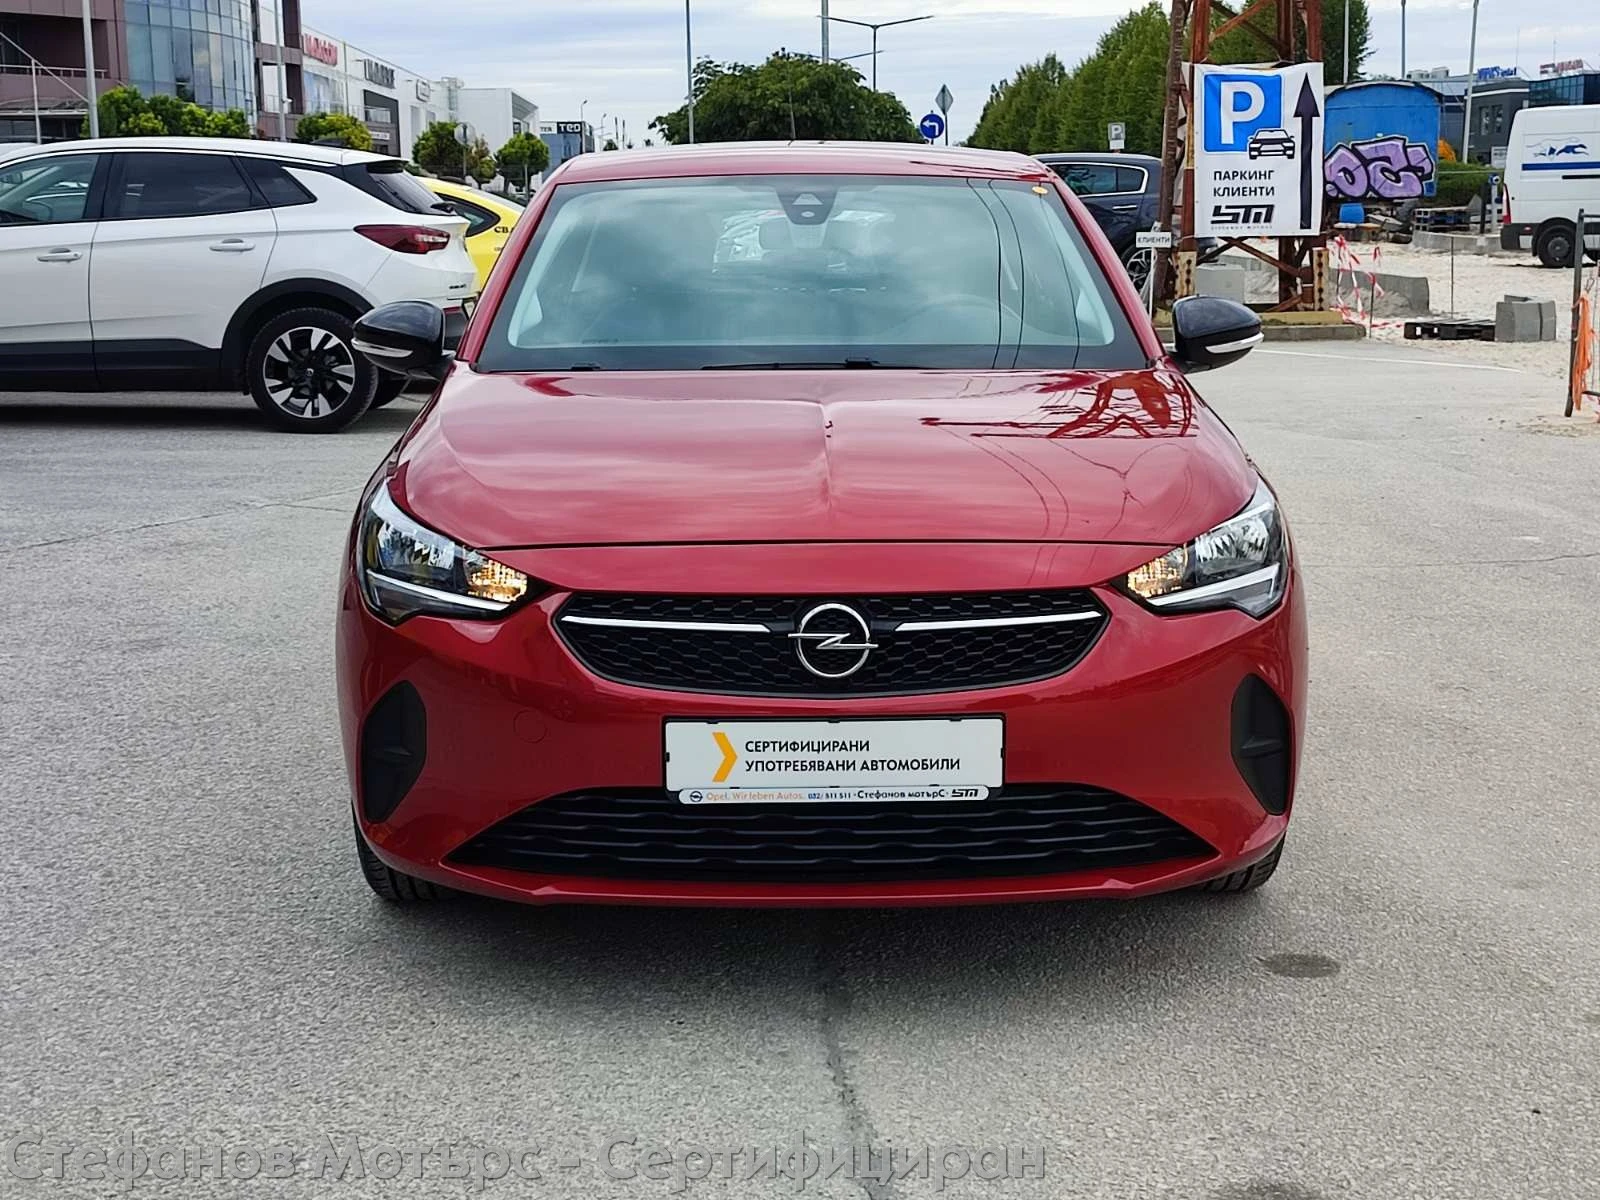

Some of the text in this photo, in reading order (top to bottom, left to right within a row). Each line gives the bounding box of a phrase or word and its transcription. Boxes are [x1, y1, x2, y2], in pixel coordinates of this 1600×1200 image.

[1220, 81, 1265, 145] P
[1213, 170, 1275, 181] ПАРКИНГ
[1213, 186, 1275, 197] КЛИЕНТИ
[745, 740, 870, 754] СЕРТИФИЦИРАНИ
[745, 758, 960, 772] УПОТРЕБЯВАНИ АВТОМОБИЛИ
